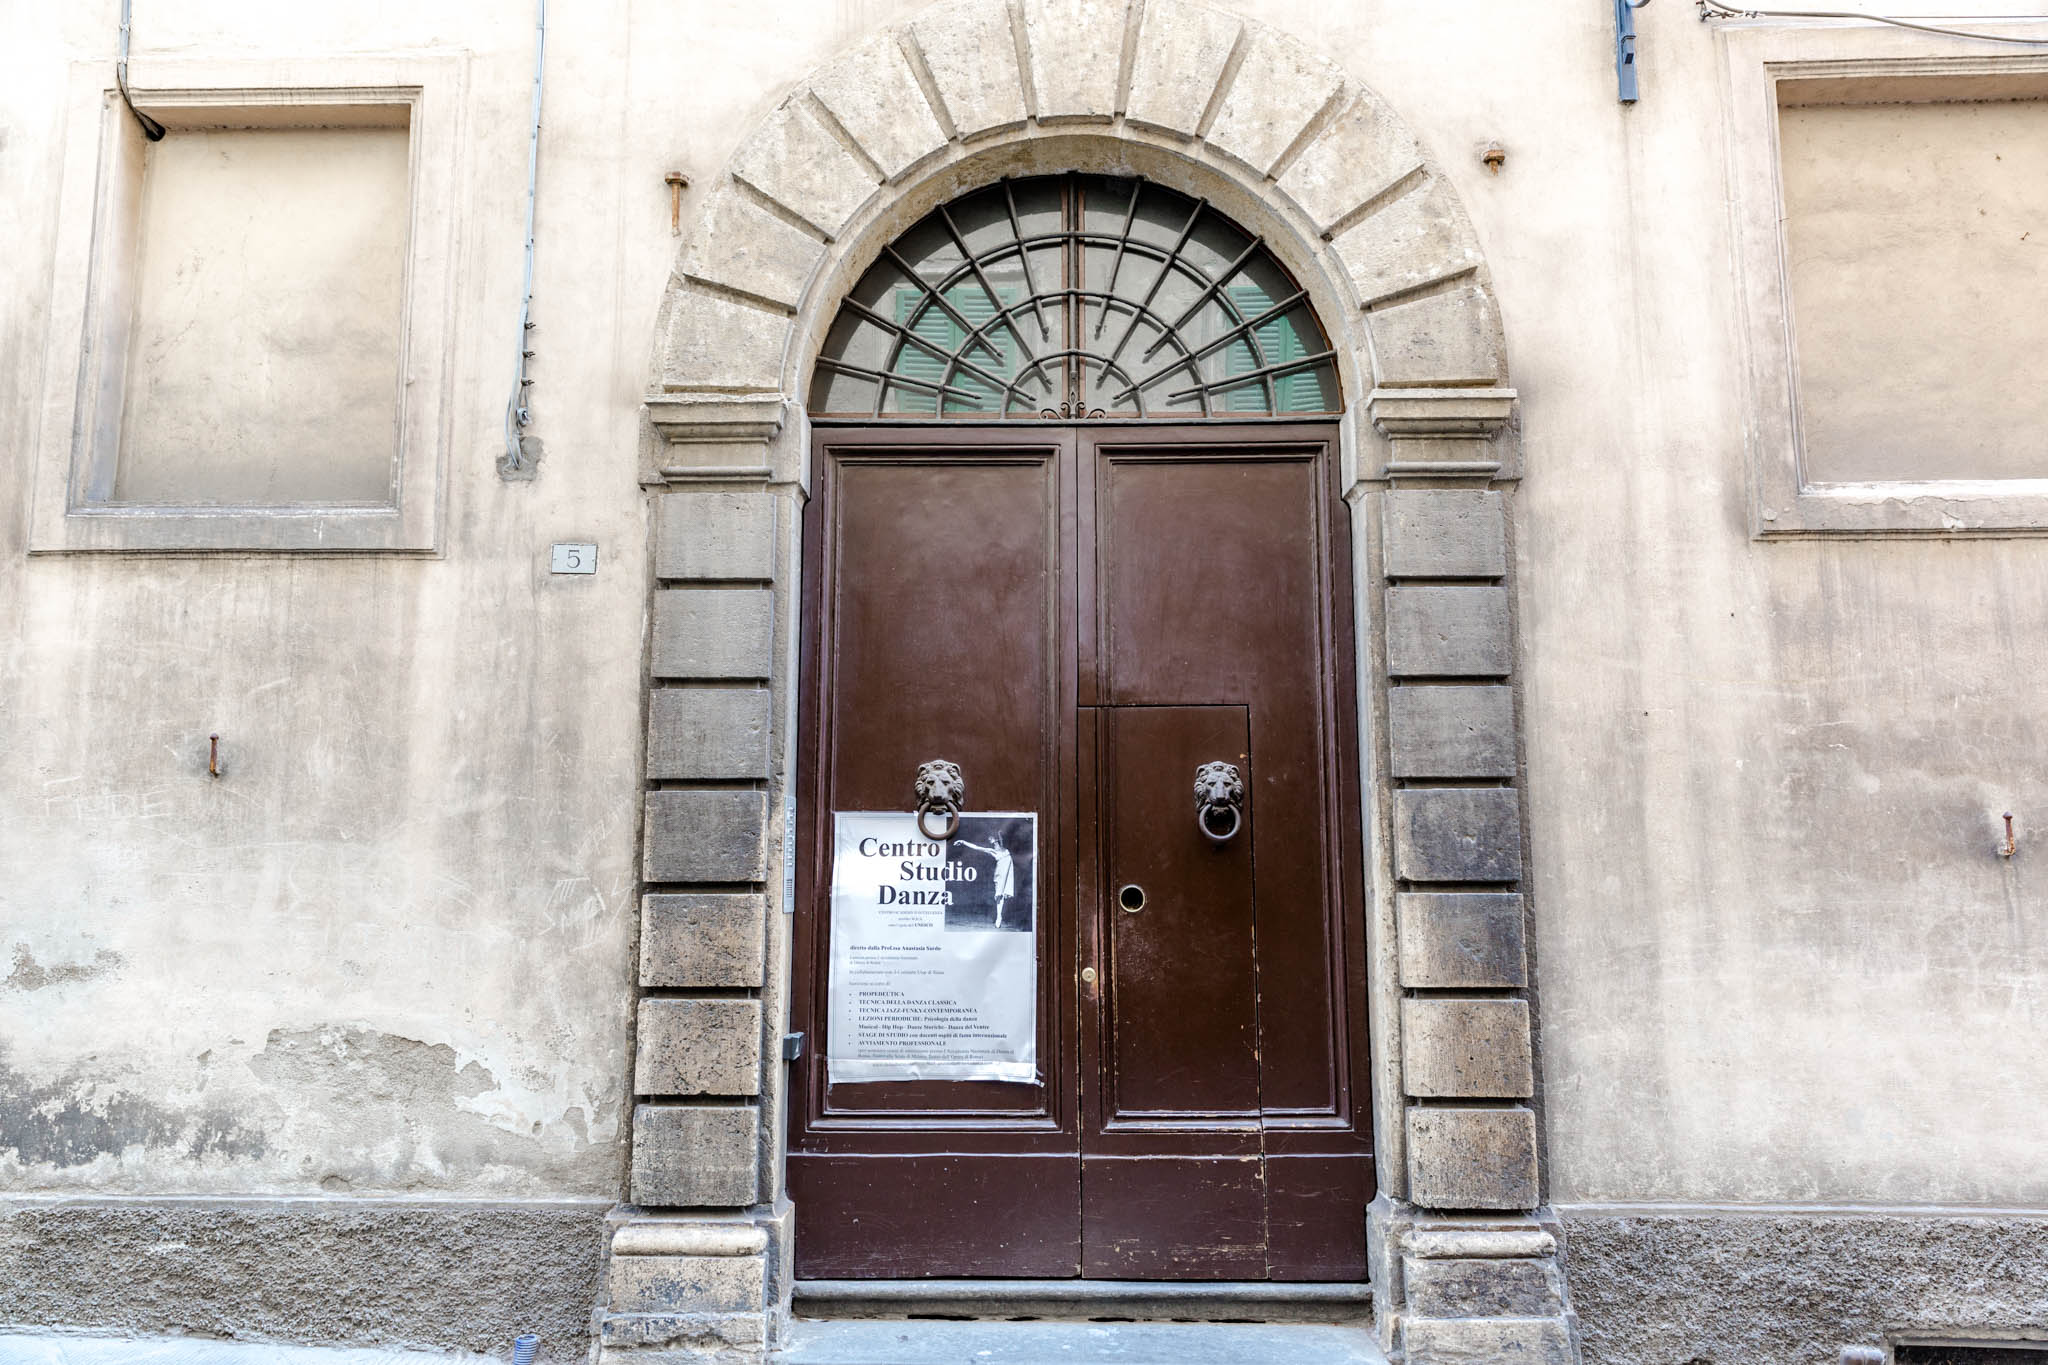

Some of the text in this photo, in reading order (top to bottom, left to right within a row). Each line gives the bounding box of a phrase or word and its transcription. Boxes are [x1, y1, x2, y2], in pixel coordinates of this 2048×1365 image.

[567, 549, 581, 569] 5
[858, 837, 941, 858] Centro
[900, 860, 978, 882] Studio
[877, 884, 954, 906] Danza
